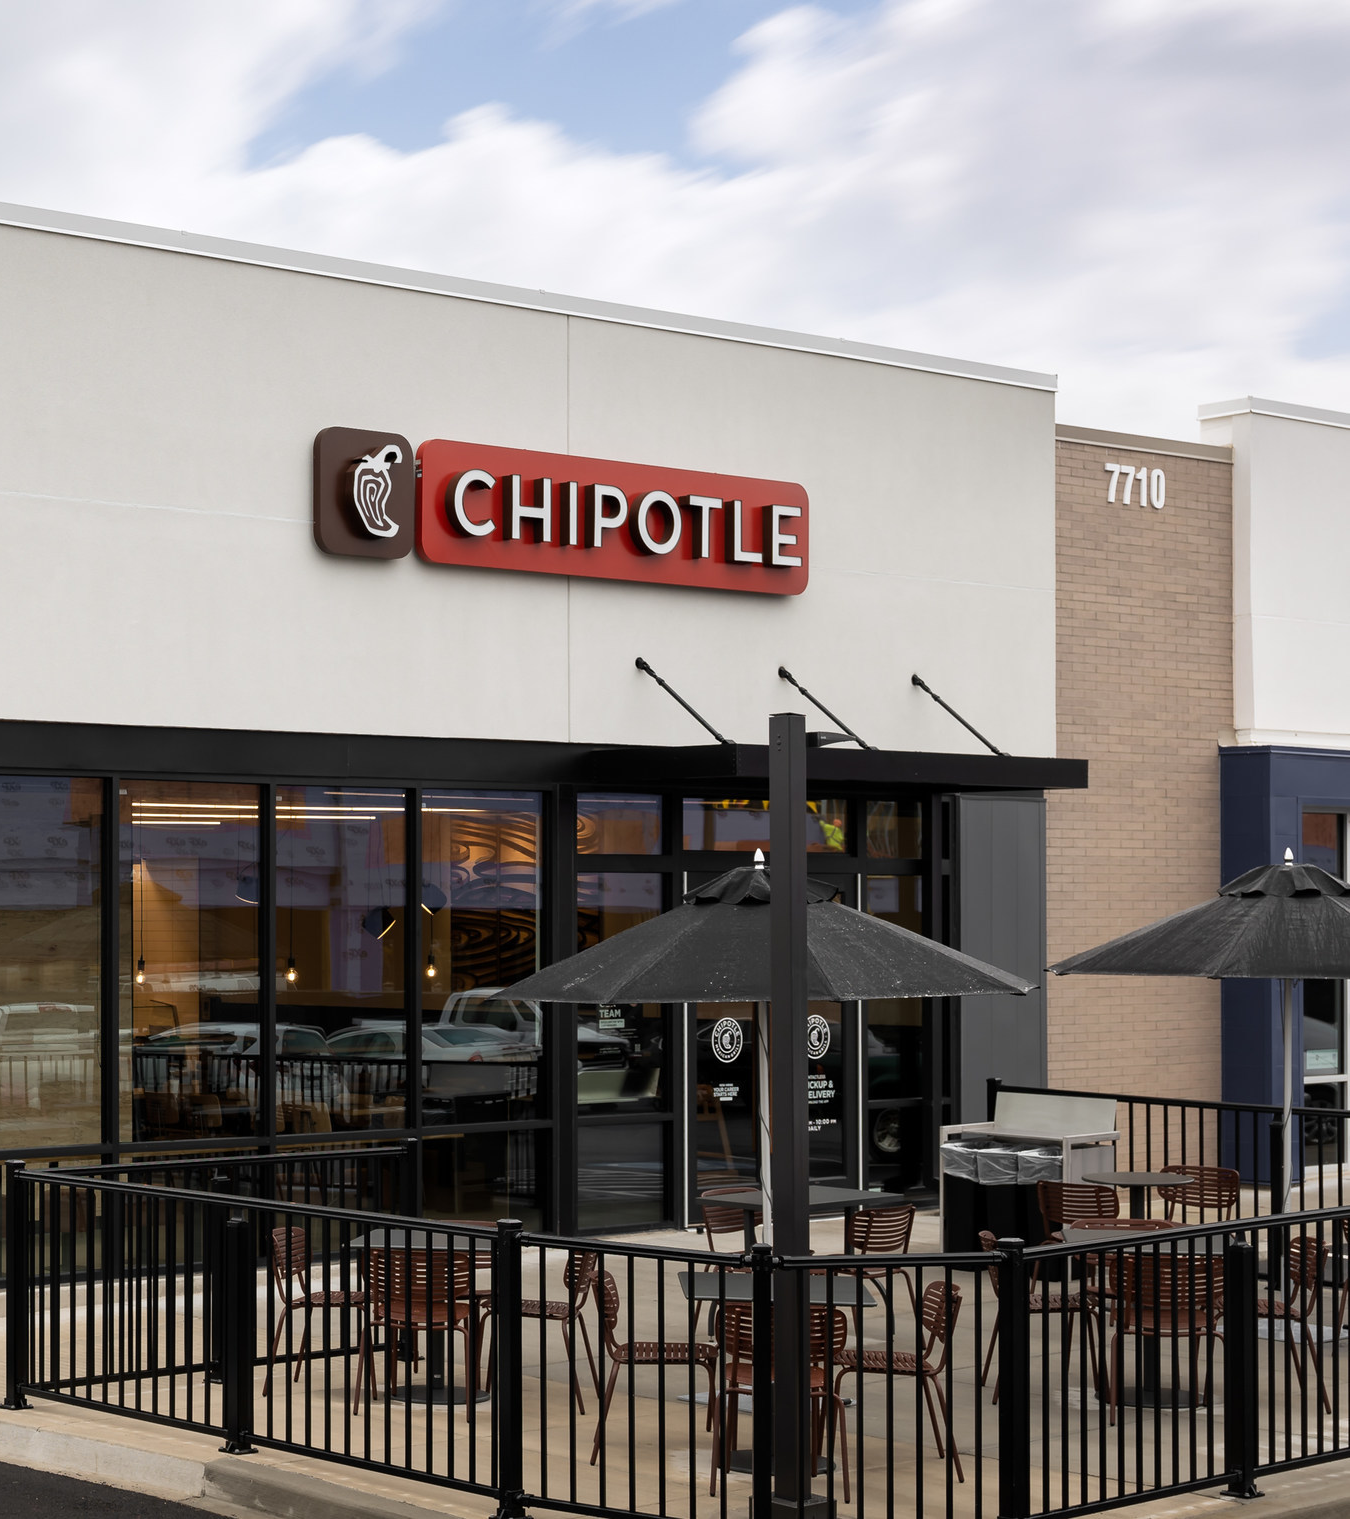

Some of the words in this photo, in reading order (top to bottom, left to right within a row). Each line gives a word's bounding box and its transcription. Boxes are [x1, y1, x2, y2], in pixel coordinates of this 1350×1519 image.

[1104, 462, 1166, 510] 7710
[451, 468, 802, 568] CHIPOTLE
[599, 1009, 621, 1018] TEAM
[714, 1020, 741, 1037] CHIPOTLE
[807, 1018, 828, 1034] IPOTLE
[807, 1080, 828, 1089] ICKUP
[828, 1079, 834, 1089] &
[808, 1089, 836, 1099] ELIVERY
